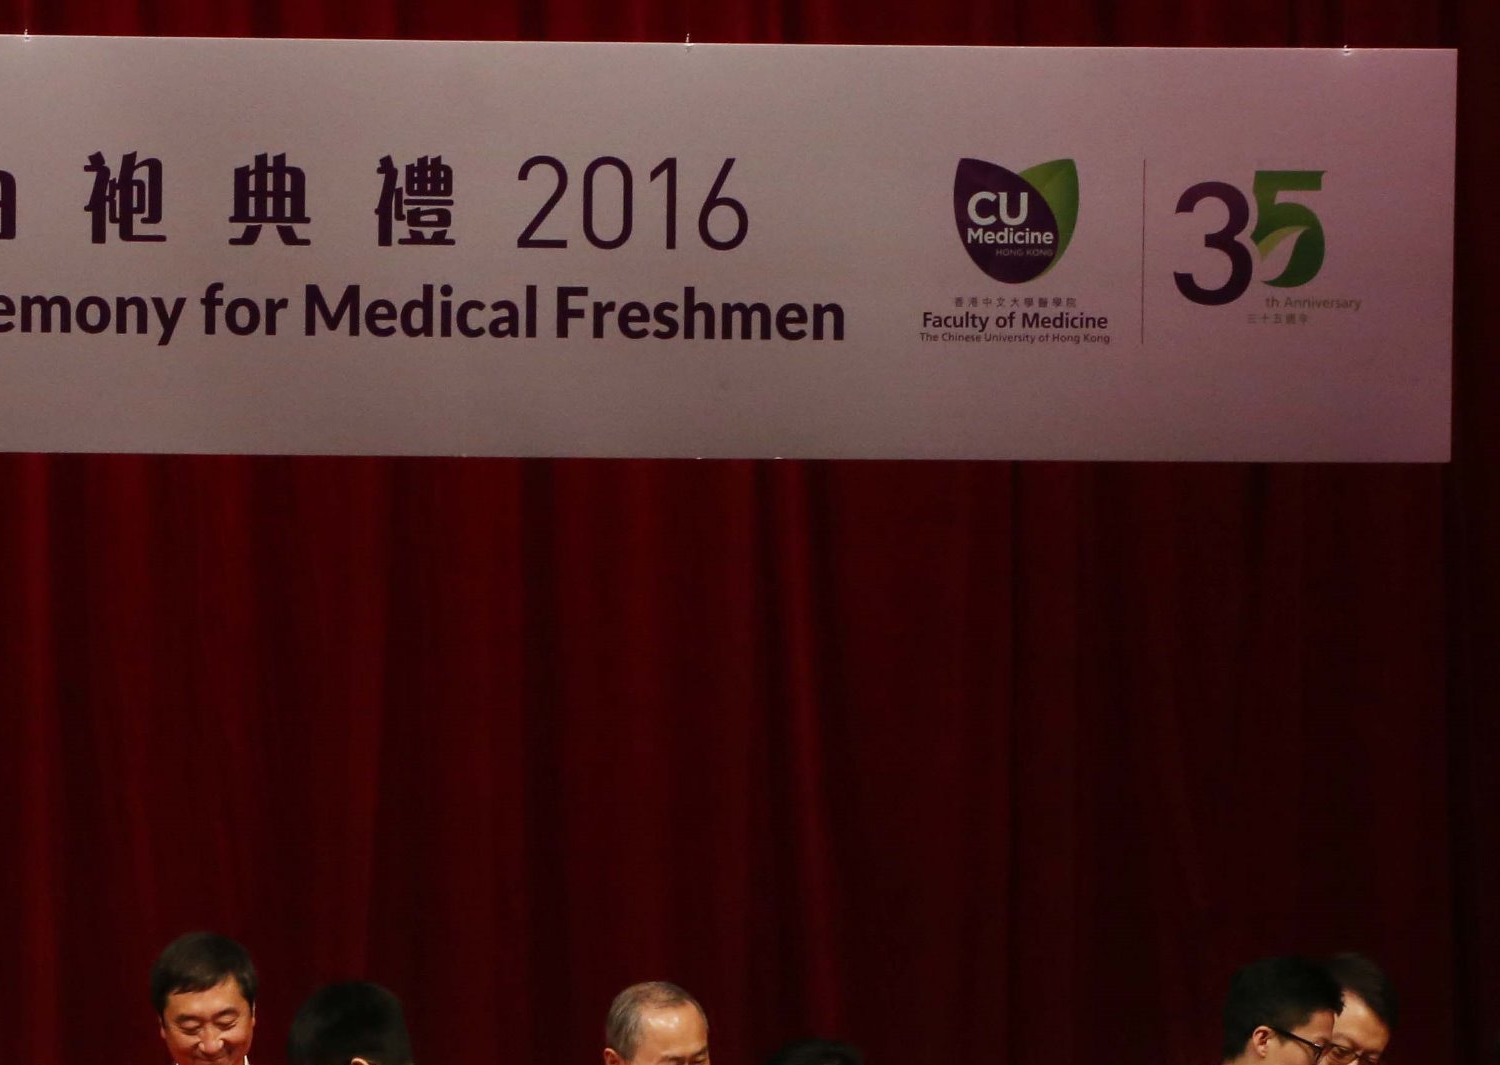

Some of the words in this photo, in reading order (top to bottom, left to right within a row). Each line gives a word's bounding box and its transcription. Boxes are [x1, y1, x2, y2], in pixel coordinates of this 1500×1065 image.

[516, 155, 749, 252] 2016
[967, 191, 1028, 226] CU
[966, 227, 1055, 245] Medicine
[1173, 170, 1327, 306] 35
[995, 248, 1023, 257] HONG
[1026, 248, 1054, 258] KONG
[199, 281, 289, 337] for
[304, 283, 537, 339] Medical
[556, 286, 845, 341] Freshmen
[1265, 297, 1280, 308] th
[1284, 297, 1362, 312] Anniversary
[923, 312, 989, 332] Faculty
[995, 312, 1015, 329] of
[1022, 312, 1108, 329] Medicine
[920, 332, 939, 342] The
[941, 332, 981, 343] Chinese
[984, 332, 1036, 345] University
[1038, 333, 1050, 343] of
[1052, 333, 1080, 345] Hong
[1083, 334, 1111, 346] Kong
